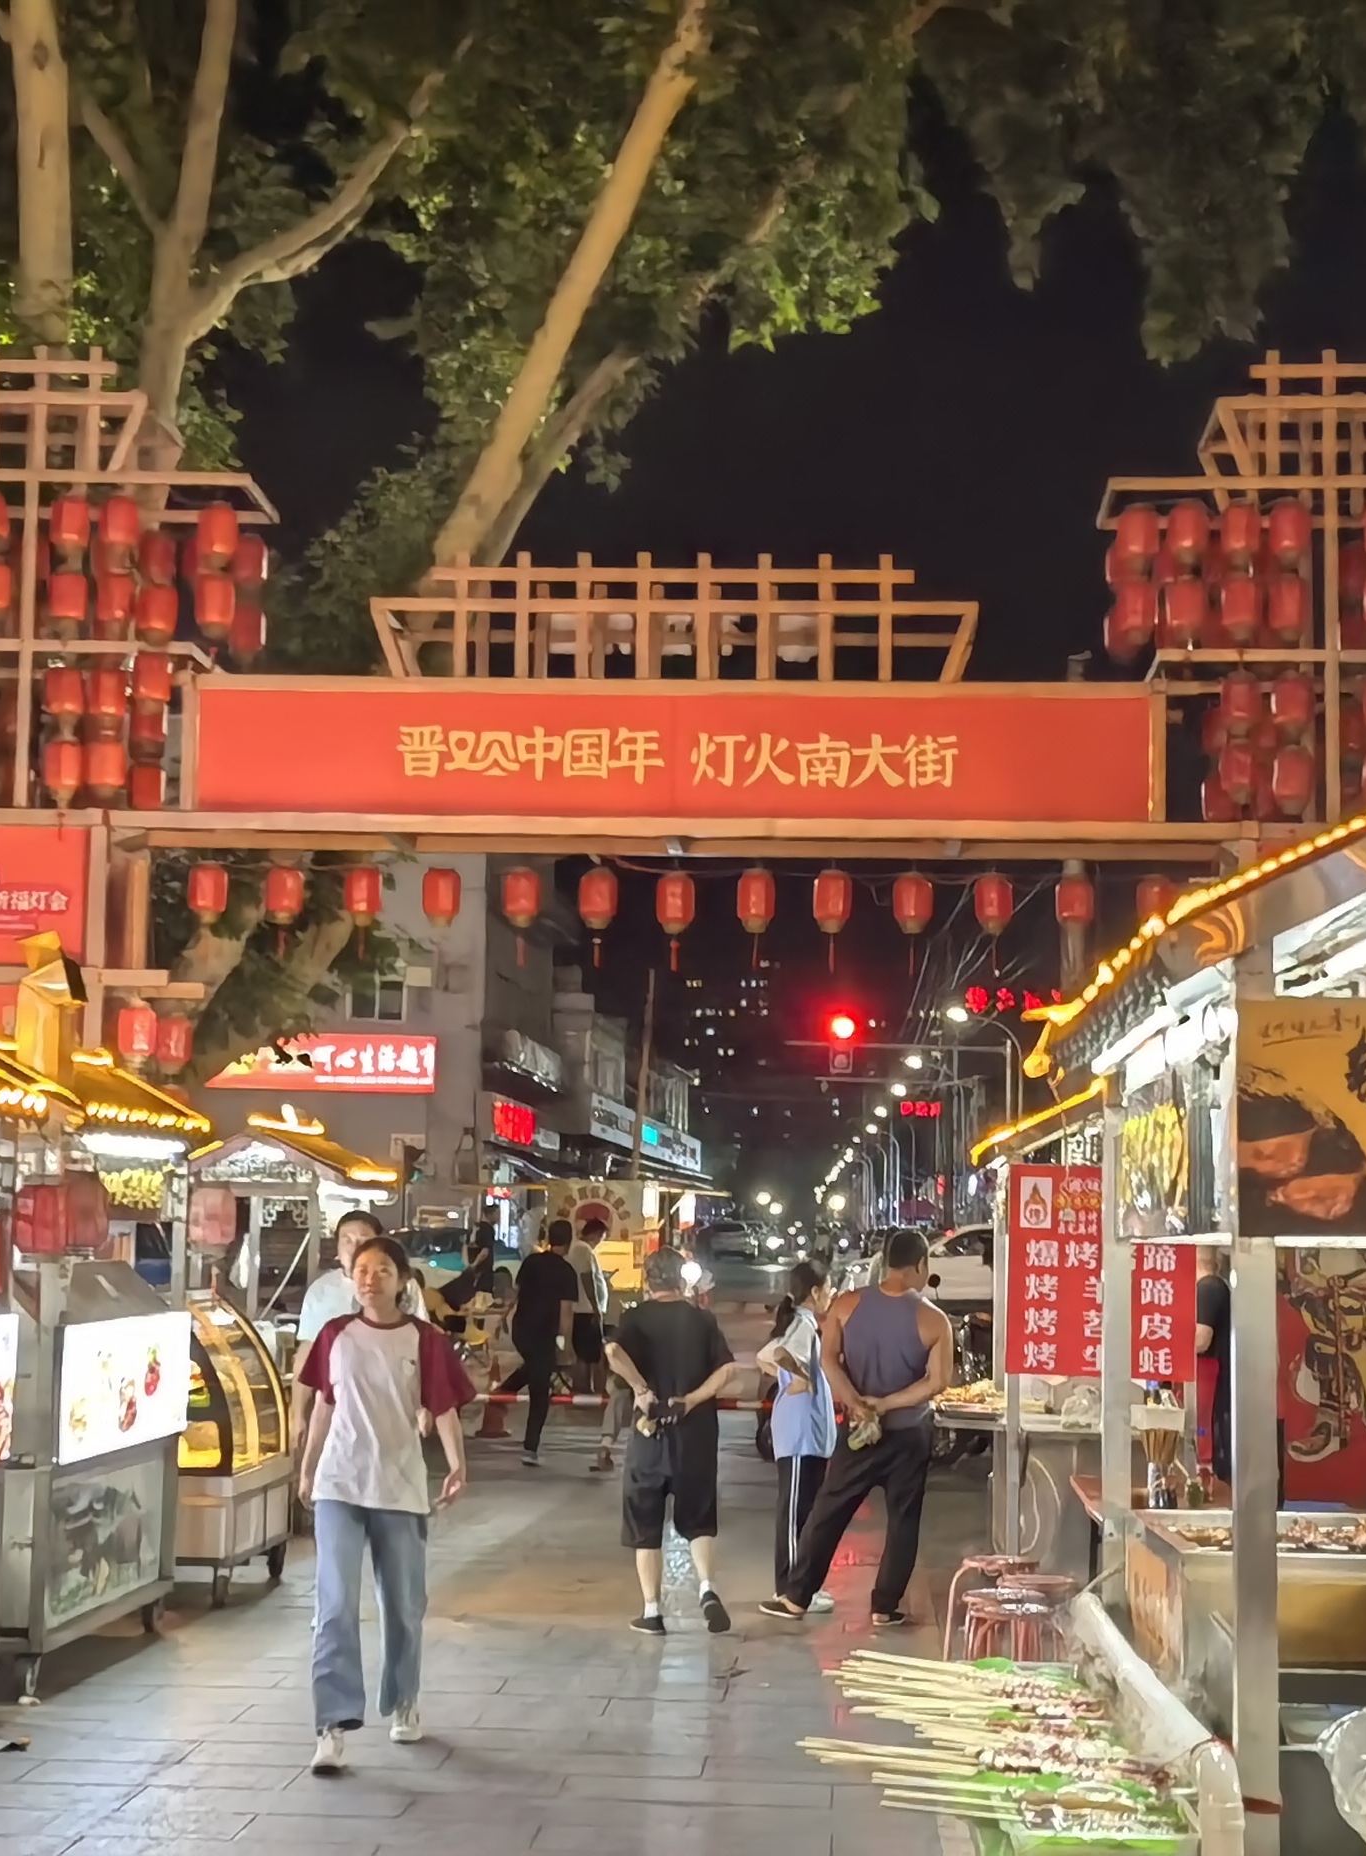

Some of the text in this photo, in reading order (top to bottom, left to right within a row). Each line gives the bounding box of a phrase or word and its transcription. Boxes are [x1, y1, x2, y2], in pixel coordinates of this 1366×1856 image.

[690, 732, 959, 788] 灯火南大街
